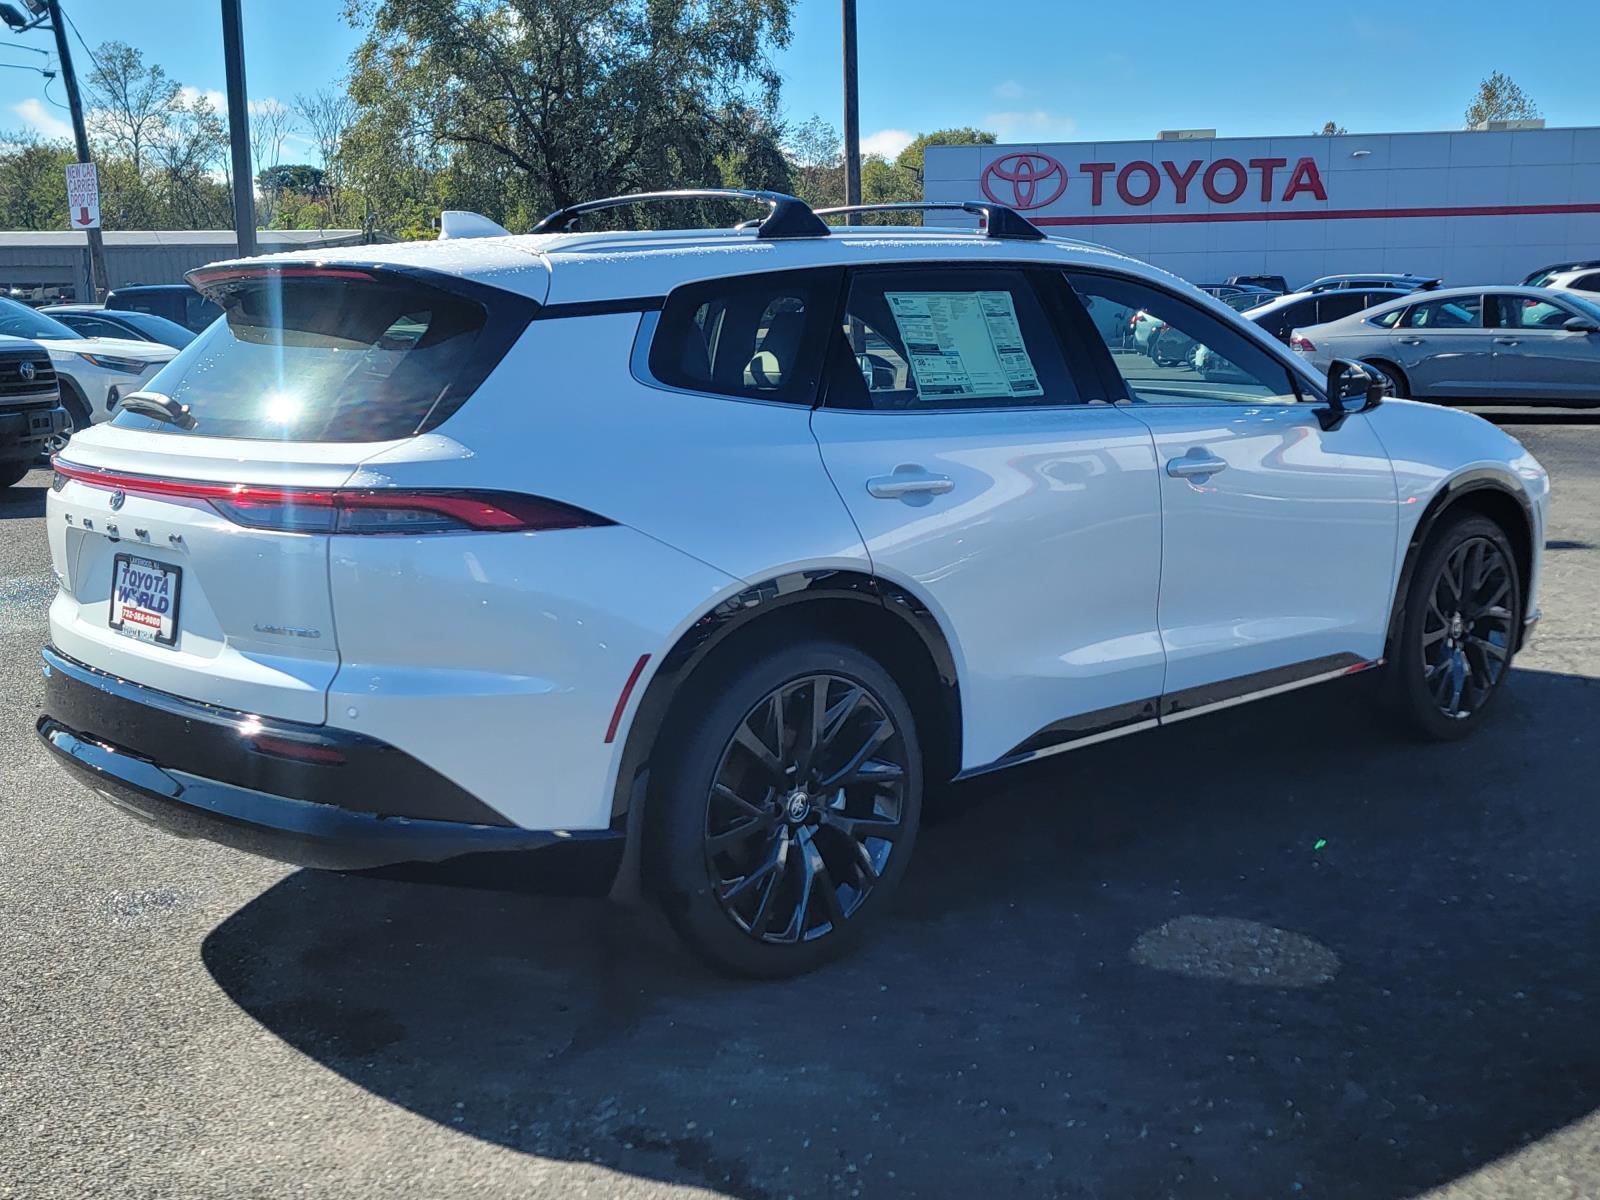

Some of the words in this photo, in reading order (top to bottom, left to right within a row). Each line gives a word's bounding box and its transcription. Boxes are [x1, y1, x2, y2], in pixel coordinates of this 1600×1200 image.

[82, 164, 95, 178] CAR
[69, 178, 97, 193] CARRIER
[1080, 157, 1328, 206] TOYOTA
[86, 192, 97, 207] OFF
[122, 567, 169, 596] TOYOTA
